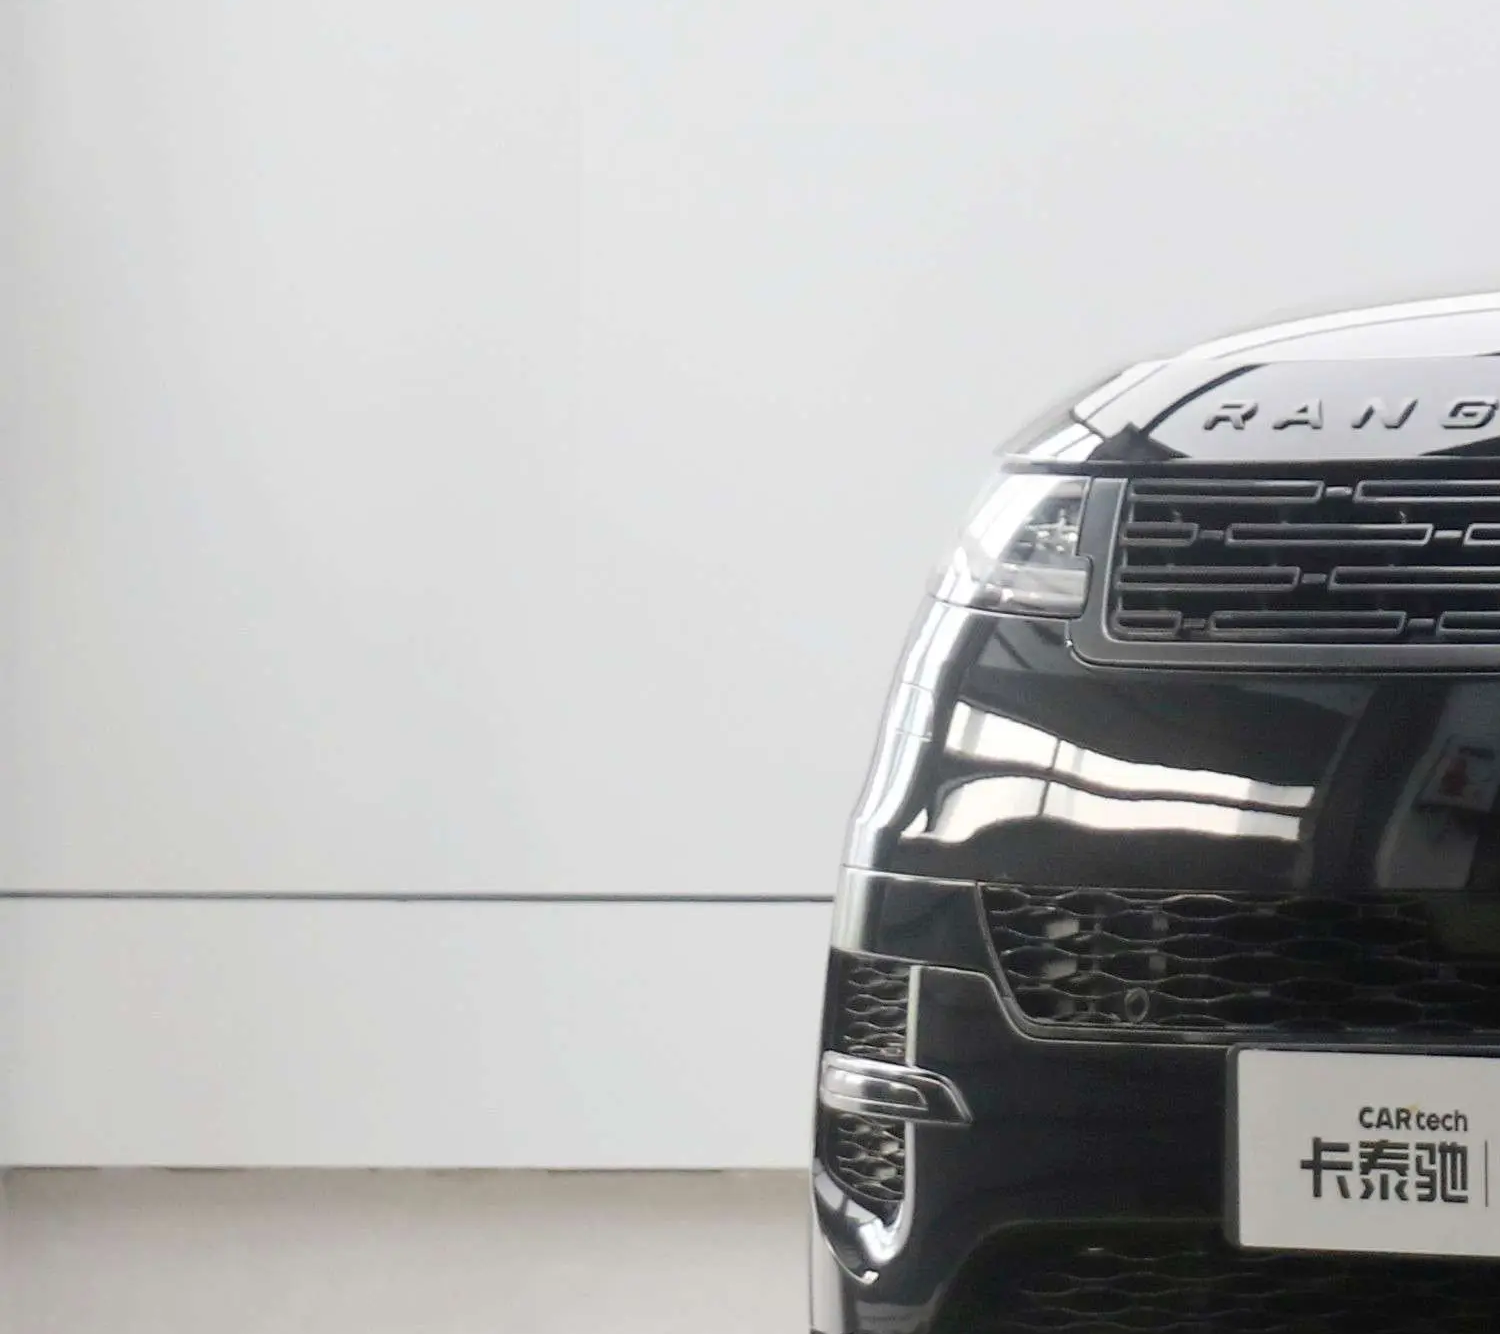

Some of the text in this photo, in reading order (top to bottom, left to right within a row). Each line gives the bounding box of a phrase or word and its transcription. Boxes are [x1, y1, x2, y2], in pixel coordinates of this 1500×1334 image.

[1357, 1105, 1469, 1133] CARtech
[1300, 1136, 1470, 1205] 卡泰驰
